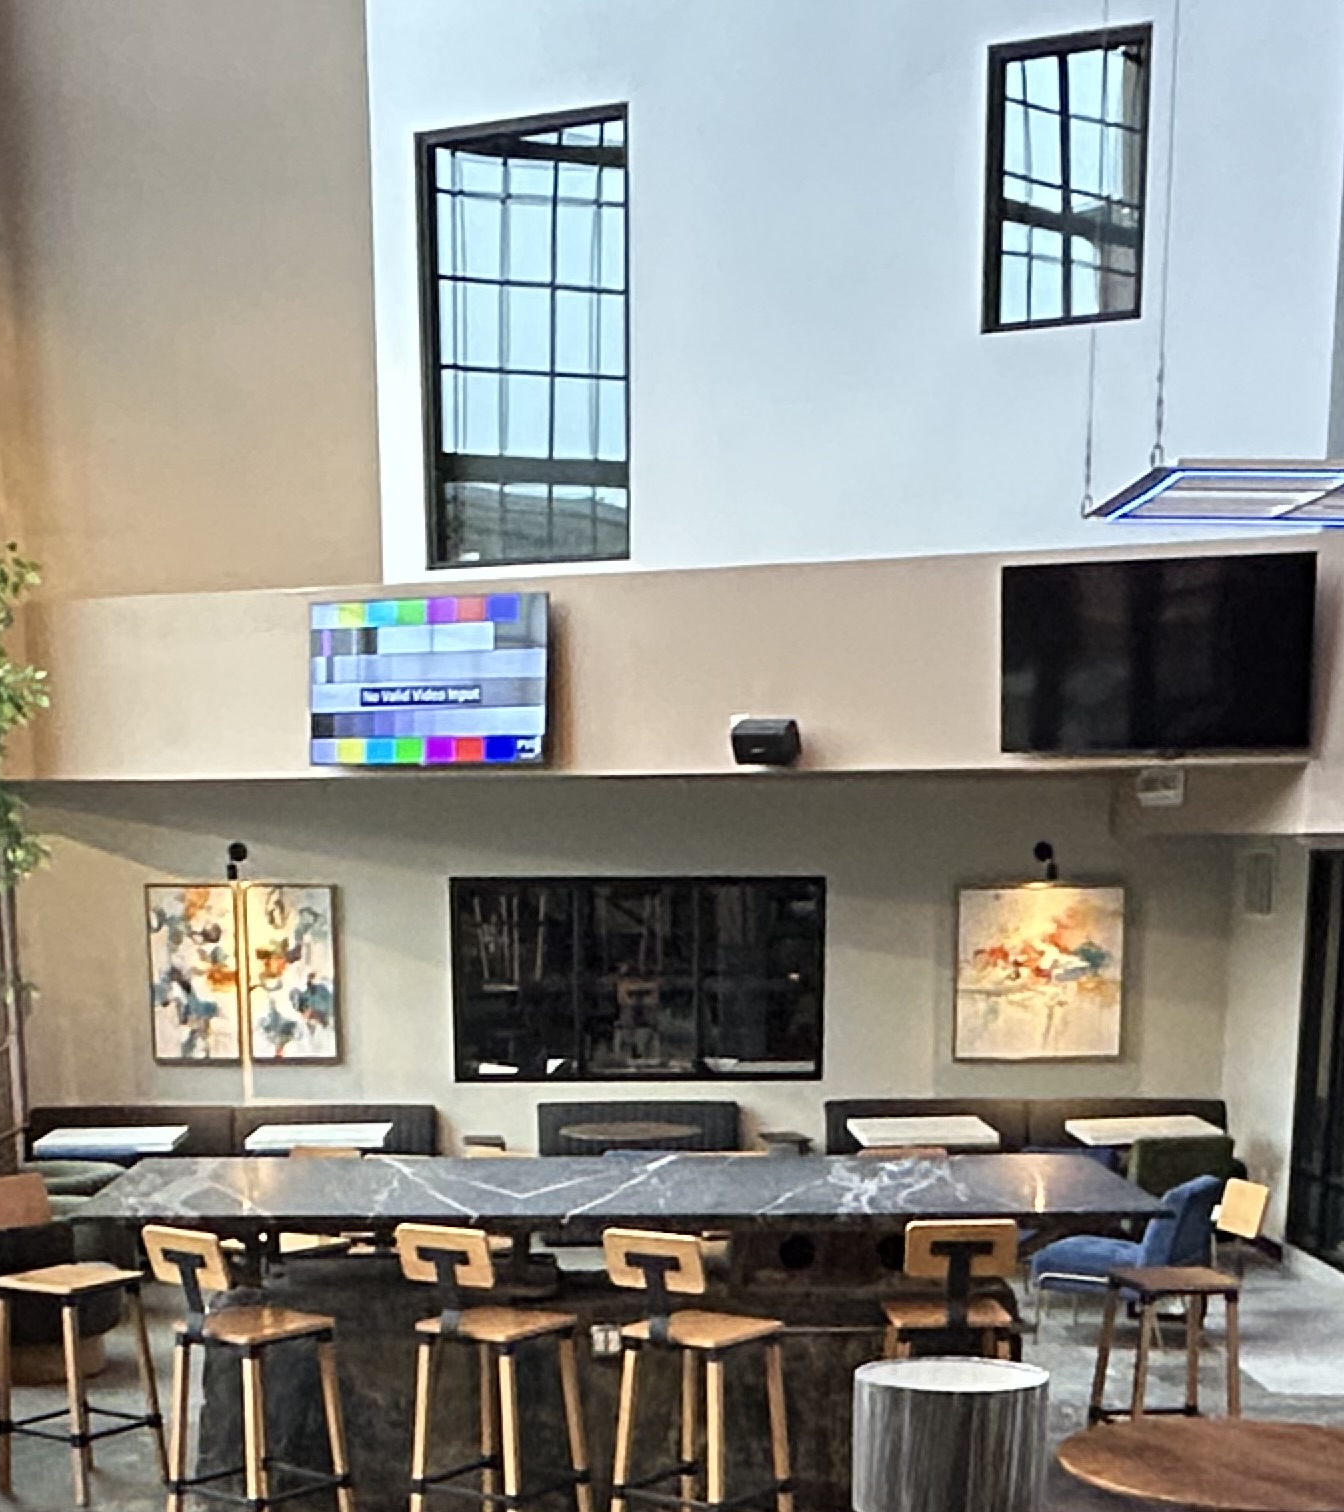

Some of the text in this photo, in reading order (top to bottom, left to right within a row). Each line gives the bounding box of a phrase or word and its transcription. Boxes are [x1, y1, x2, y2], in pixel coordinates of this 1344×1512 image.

[362, 688, 480, 703] No Valid Video Input
